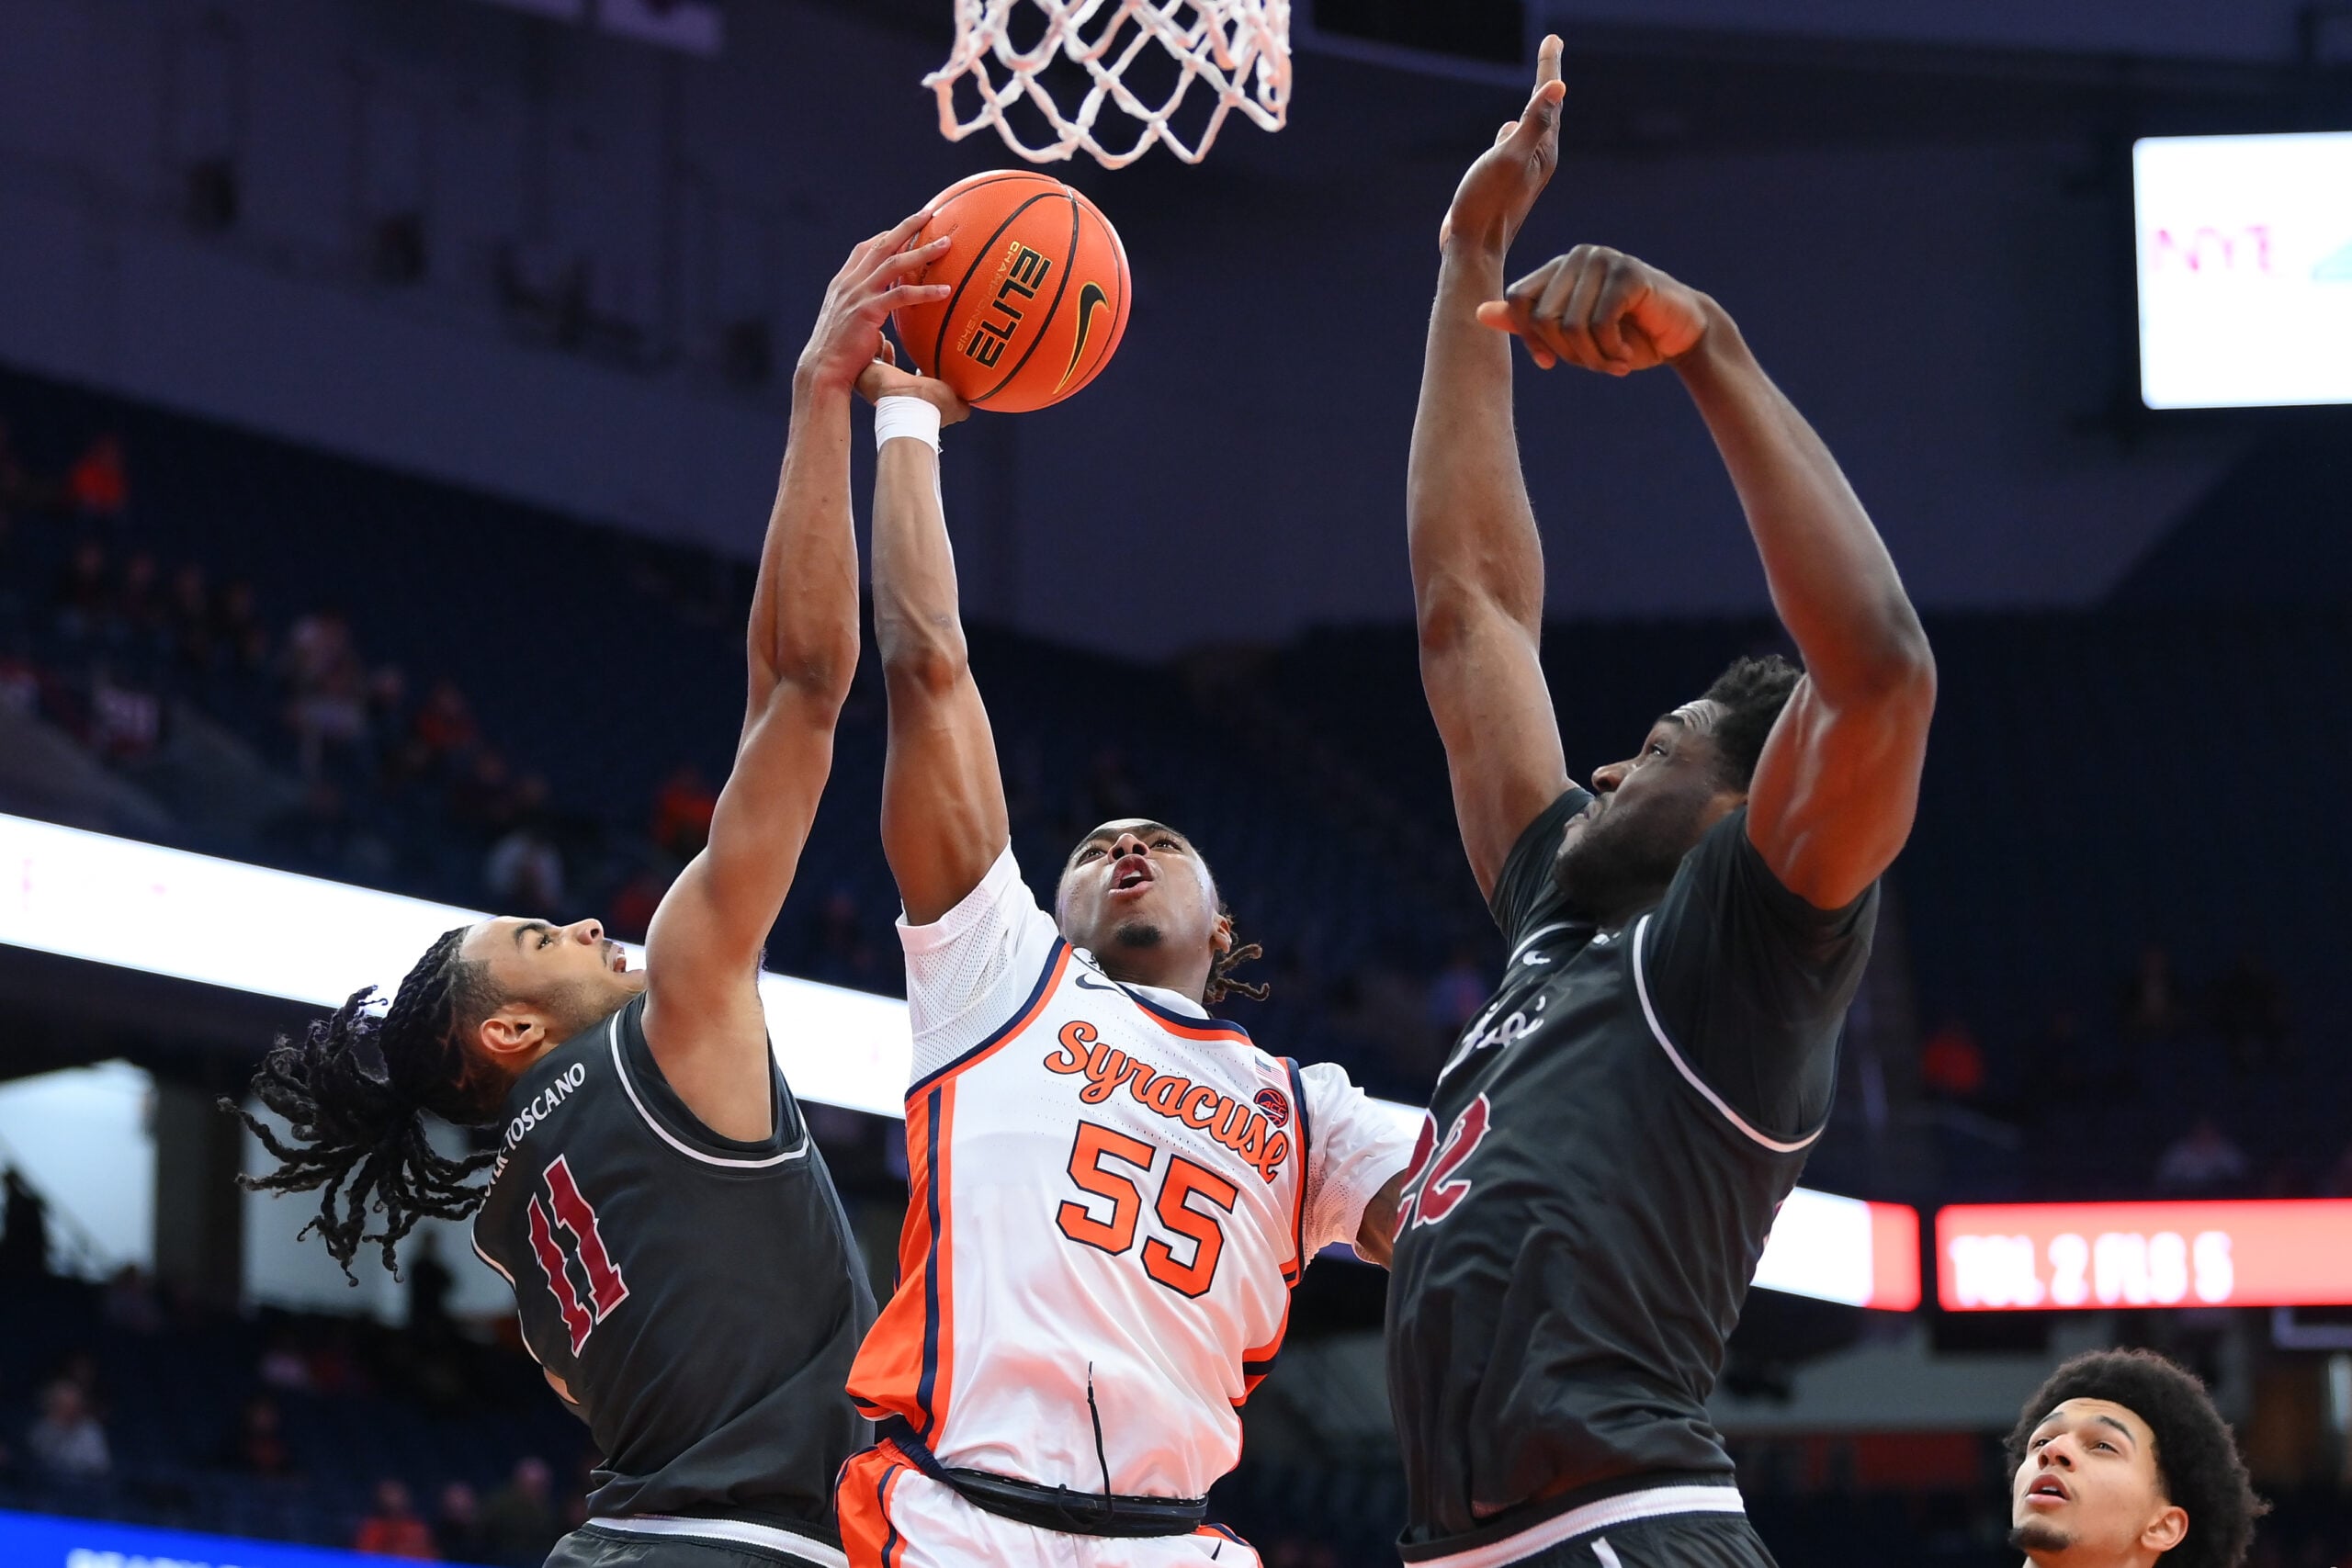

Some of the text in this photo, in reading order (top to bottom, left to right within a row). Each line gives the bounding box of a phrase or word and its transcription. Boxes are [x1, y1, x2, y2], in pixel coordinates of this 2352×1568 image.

[965, 245, 1053, 369] ELITE
[1044, 1020, 1288, 1185] Syracuse
[1260, 1100, 1287, 1117] ACC
[526, 1153, 630, 1359] 11
[1056, 1118, 1239, 1299] 55
